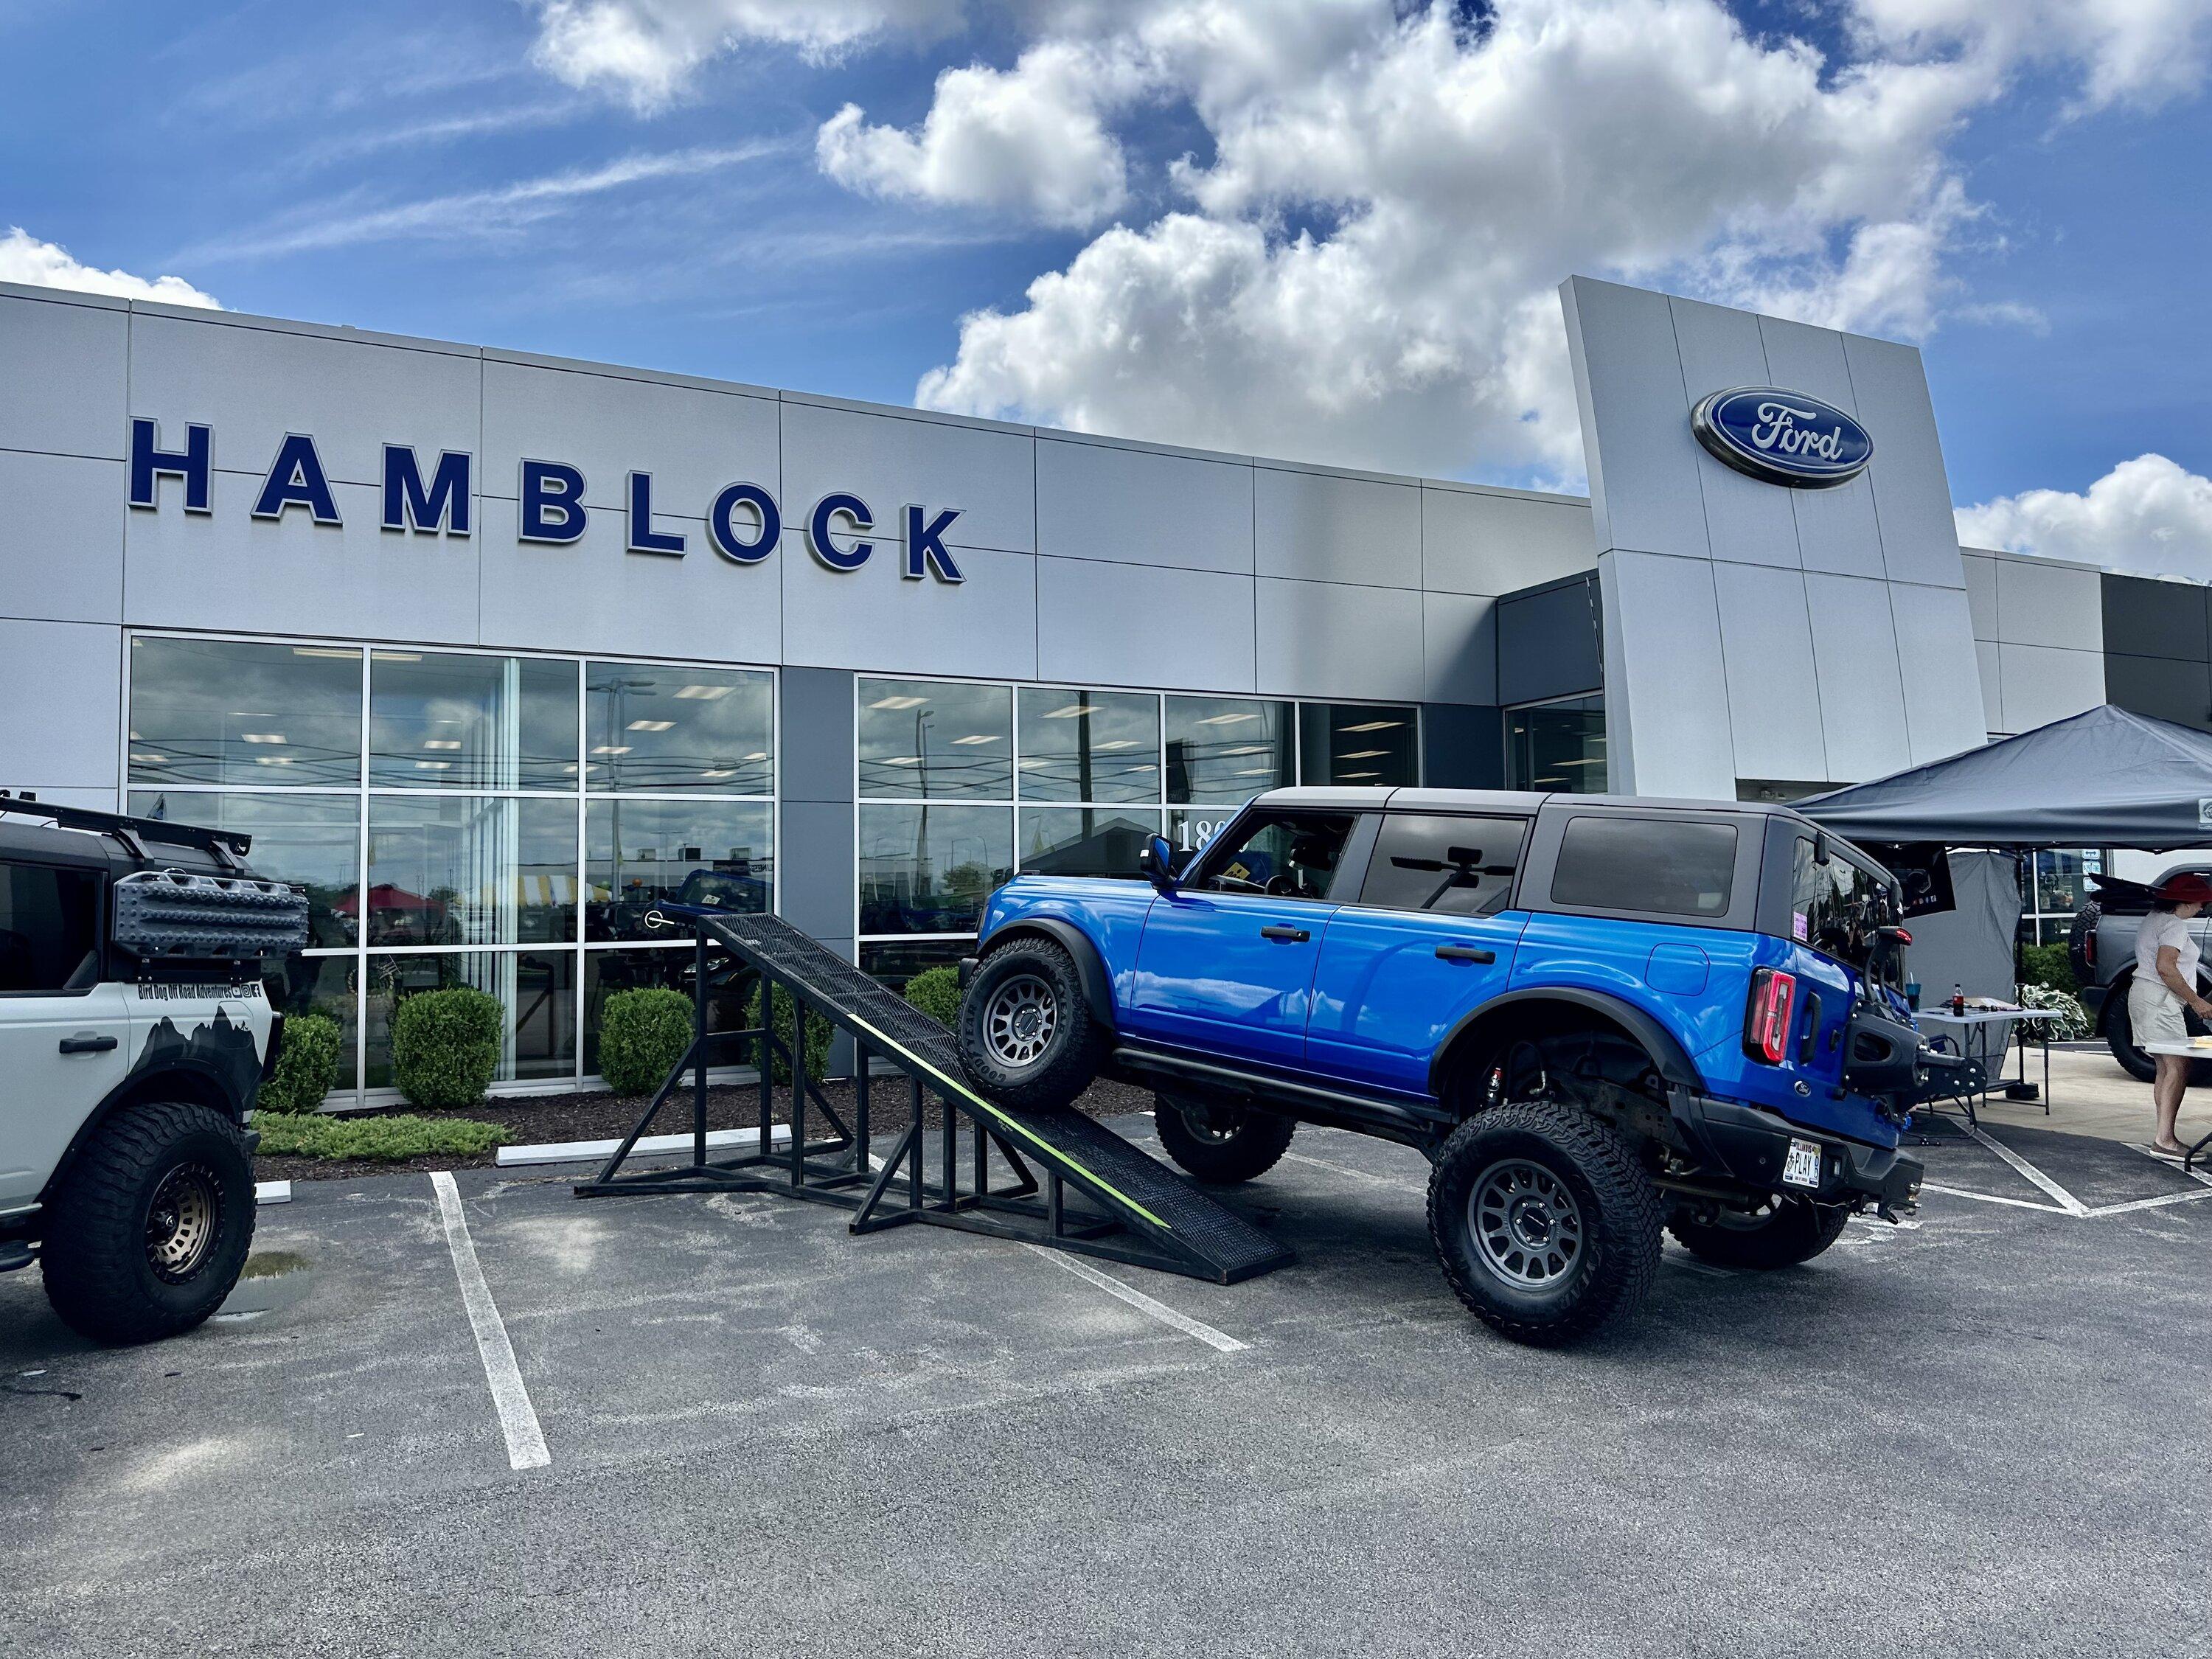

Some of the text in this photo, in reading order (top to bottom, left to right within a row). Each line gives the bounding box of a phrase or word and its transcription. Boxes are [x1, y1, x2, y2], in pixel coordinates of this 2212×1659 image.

[1751, 402, 1843, 461] Ford
[128, 415, 967, 584] HAMBLOCK
[138, 984, 232, 1001] Bird Dog Off Road Adventures
[1794, 1152, 1812, 1177] PLAY
